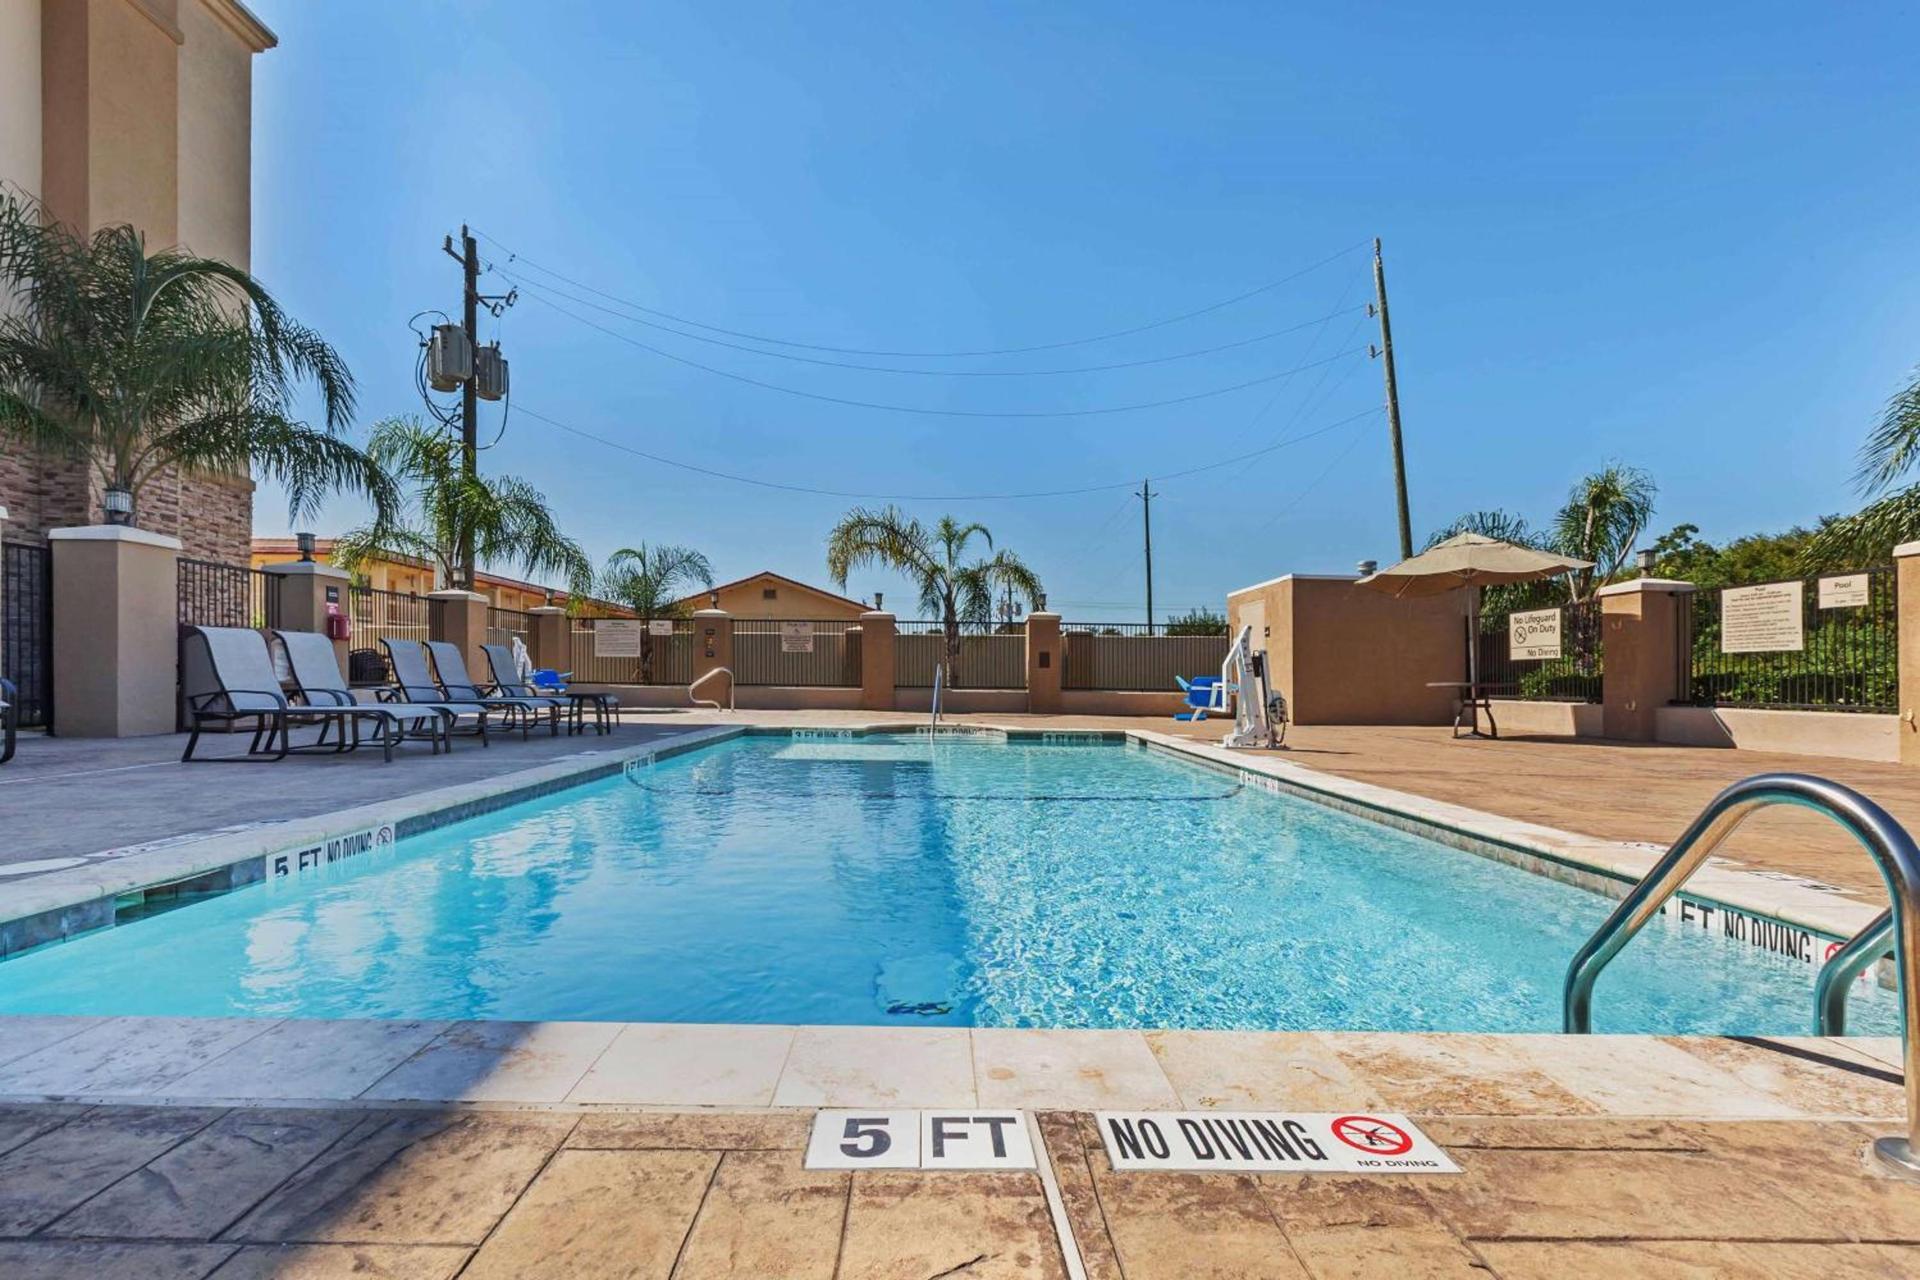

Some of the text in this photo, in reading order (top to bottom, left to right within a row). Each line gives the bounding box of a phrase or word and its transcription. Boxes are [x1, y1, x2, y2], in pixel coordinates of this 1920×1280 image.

[1525, 611, 1556, 624] Lifeguard
[1539, 624, 1556, 633] Duty
[1538, 648, 1558, 657] Diving
[274, 856, 289, 876] 5
[298, 847, 322, 871] FT
[326, 840, 341, 864] NO
[1681, 900, 1811, 964] FT NO DIVING
[839, 1117, 1017, 1158] 5 FT
[1108, 1118, 1328, 1161] NO DIVING
